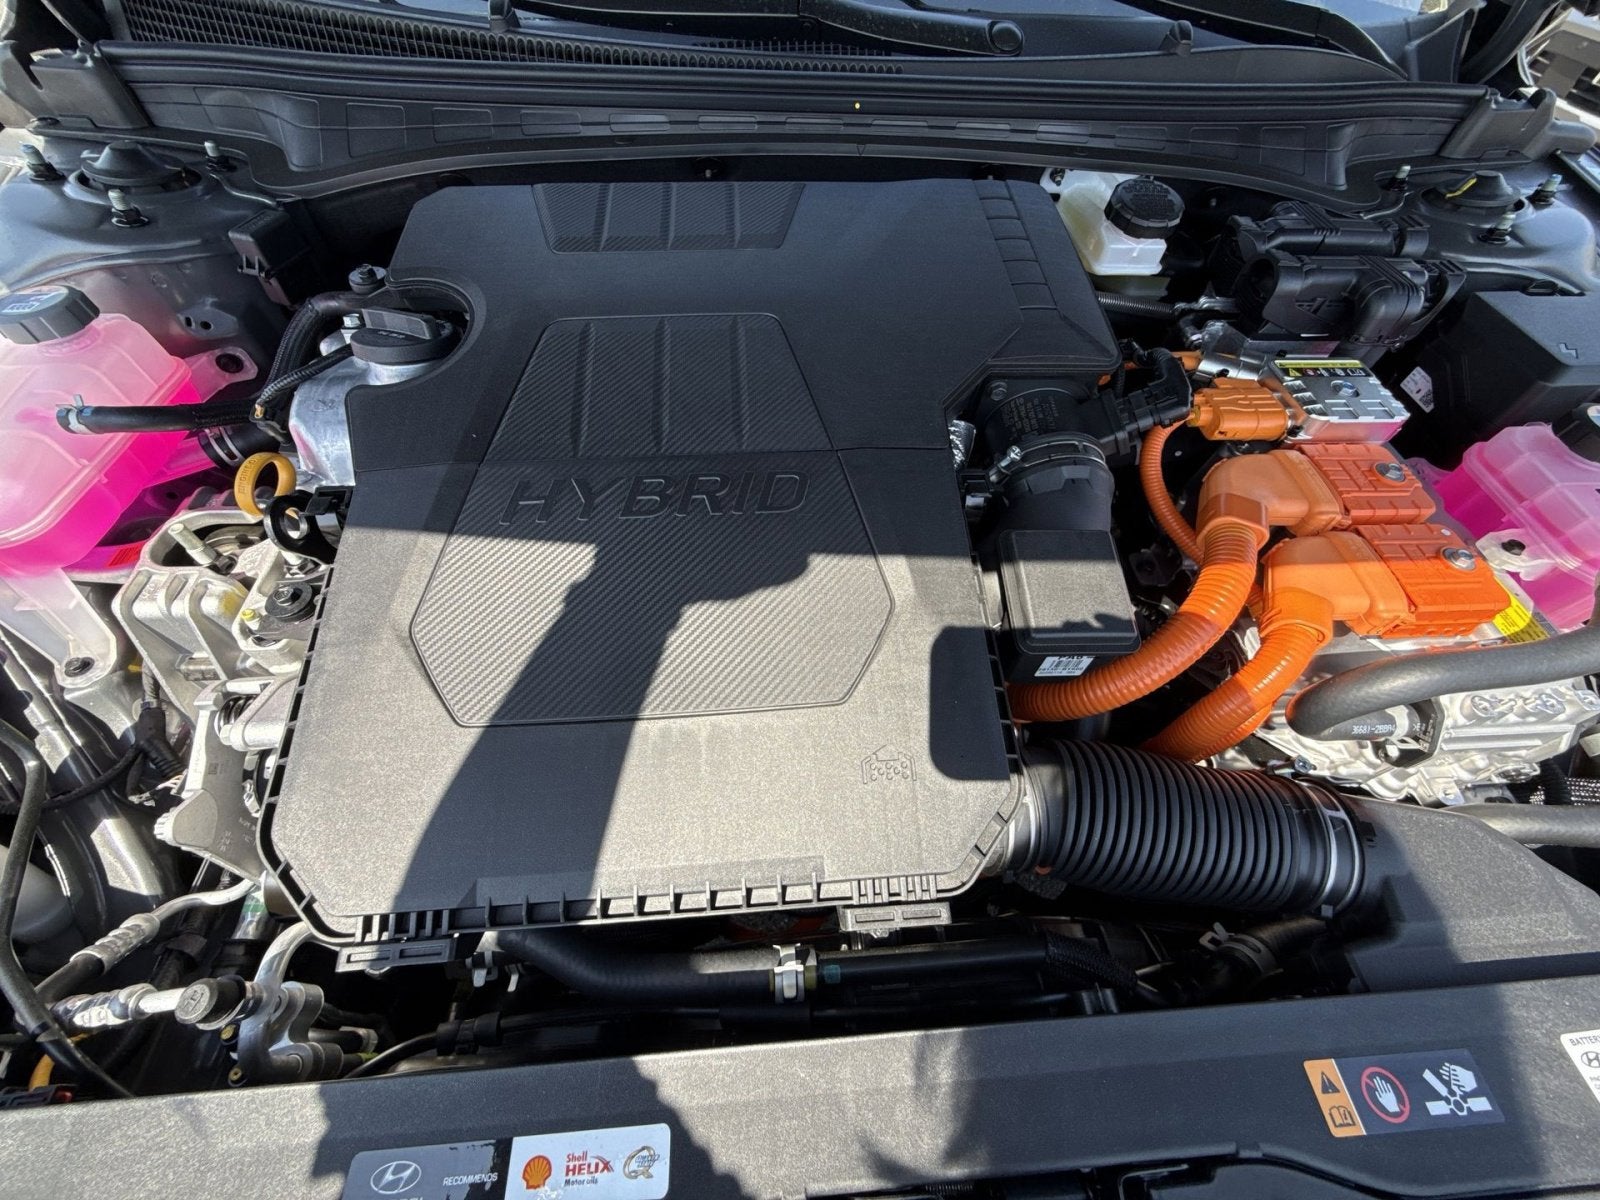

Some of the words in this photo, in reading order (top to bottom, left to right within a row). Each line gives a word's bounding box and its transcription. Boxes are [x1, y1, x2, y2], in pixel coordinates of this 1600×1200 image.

[499, 470, 810, 525] HYBRID
[566, 1150, 588, 1163] Shell
[565, 1160, 614, 1177] HELIX
[442, 1172, 499, 1186] RECOMMENDS
[564, 1178, 585, 1187] Motor
